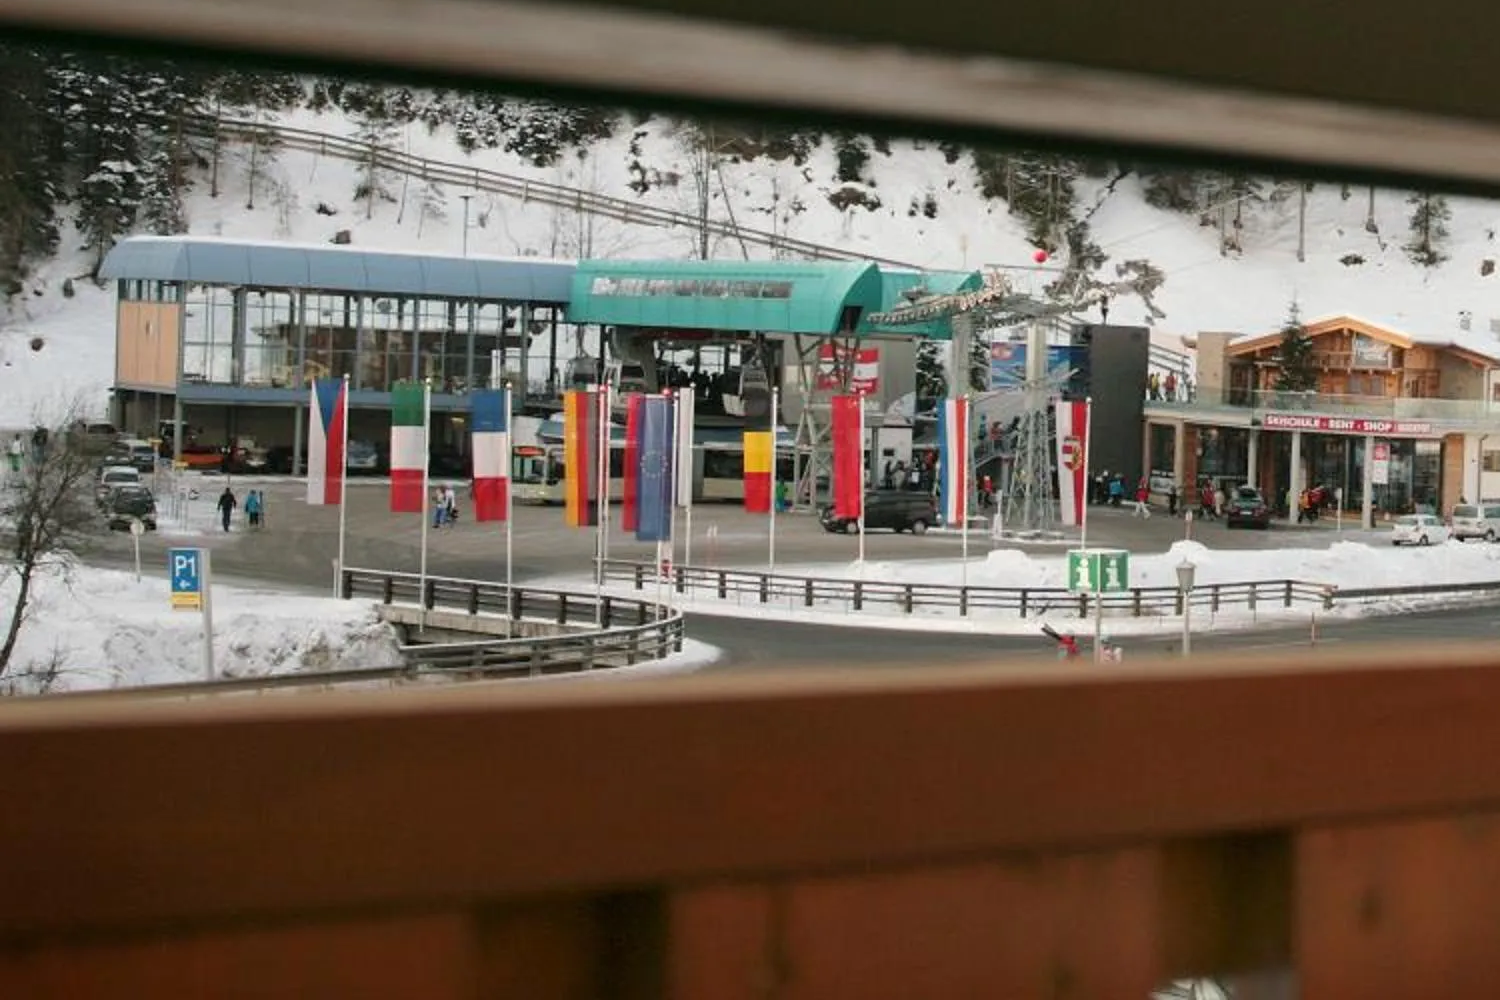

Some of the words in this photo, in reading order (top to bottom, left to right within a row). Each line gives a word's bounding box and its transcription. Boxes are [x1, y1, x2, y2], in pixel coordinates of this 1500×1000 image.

[1328, 418, 1354, 431] RENT
[1363, 420, 1393, 433] SHOP
[175, 555, 195, 577] P1
